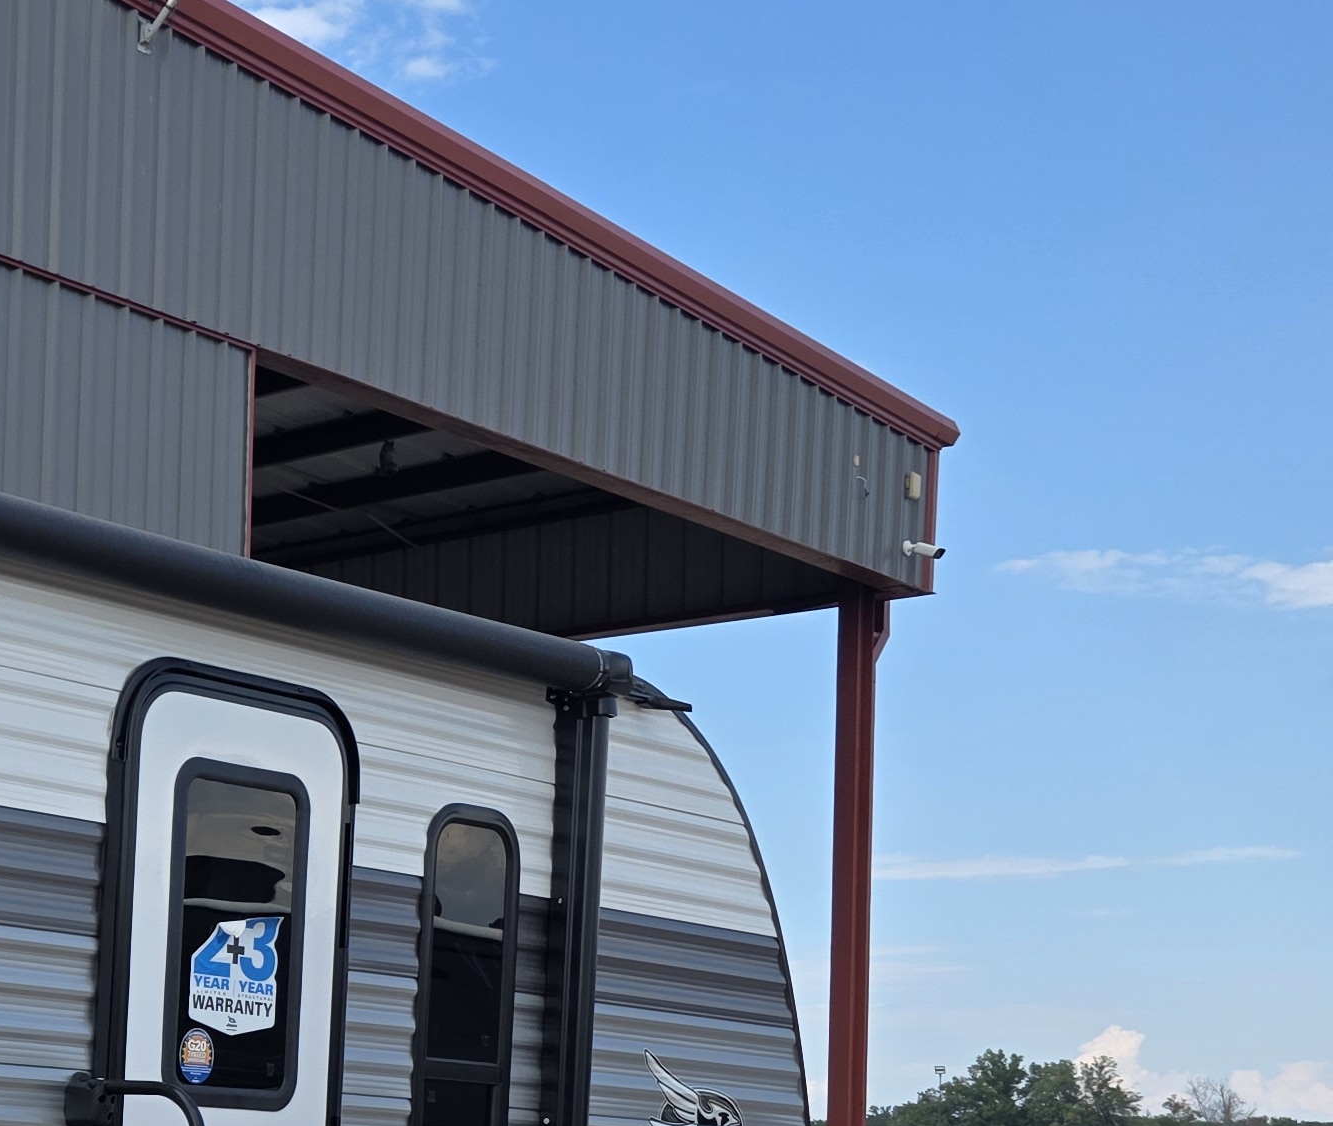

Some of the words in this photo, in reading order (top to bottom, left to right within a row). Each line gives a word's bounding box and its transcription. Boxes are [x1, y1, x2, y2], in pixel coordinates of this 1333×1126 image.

[194, 975, 230, 990] YEAR
[239, 981, 274, 996] YEAR
[193, 994, 273, 1018] WARRANTY
[187, 1040, 207, 1052] G20
